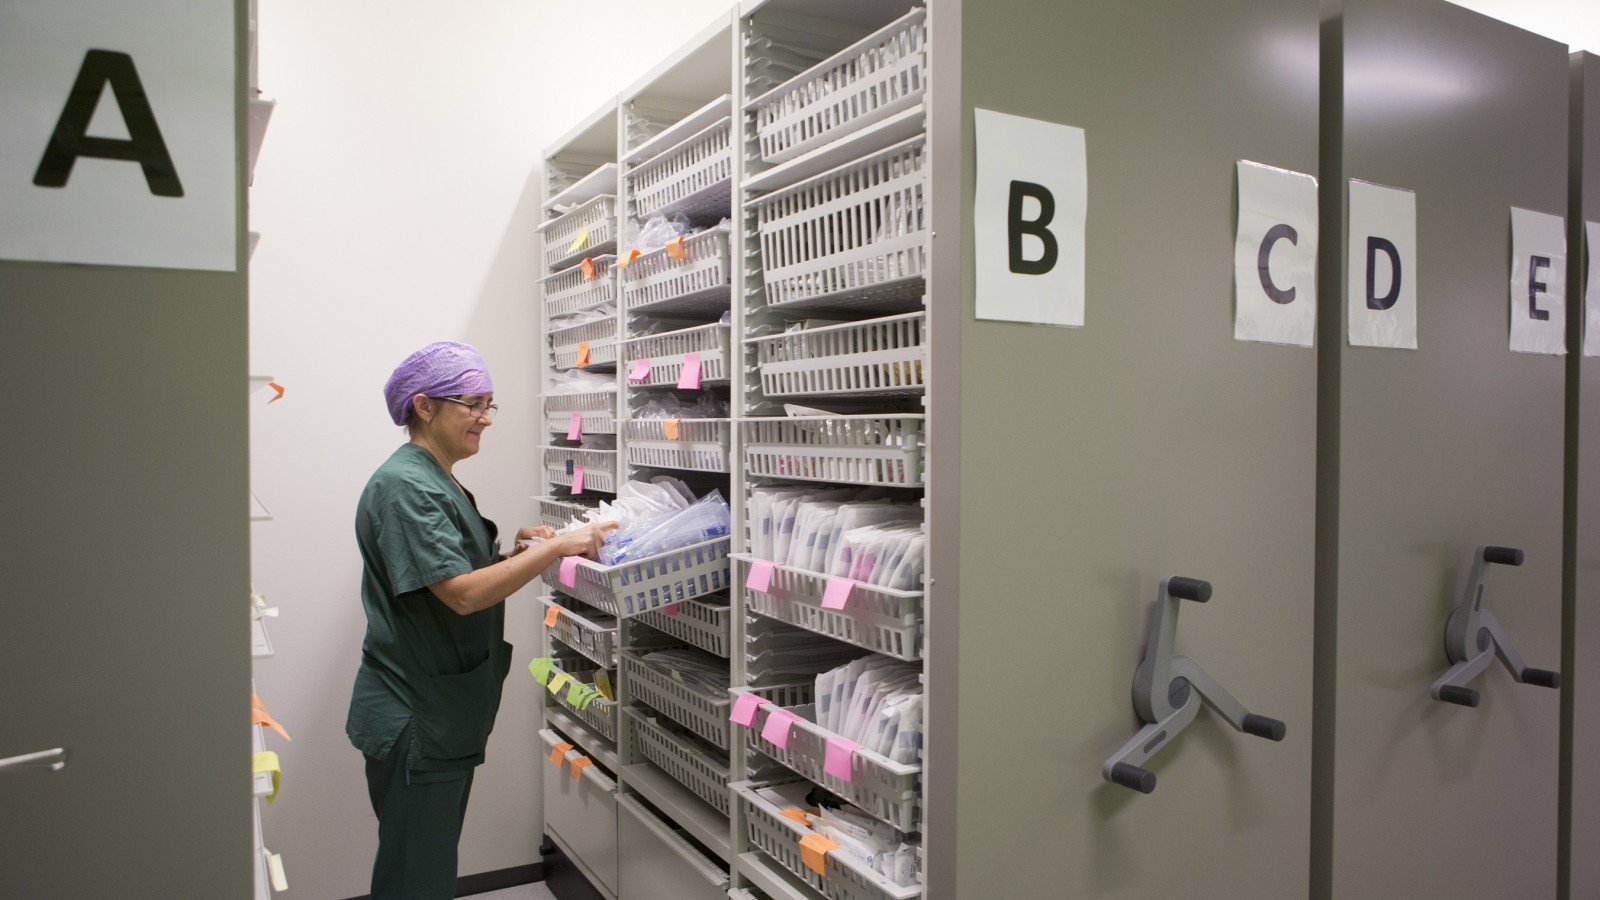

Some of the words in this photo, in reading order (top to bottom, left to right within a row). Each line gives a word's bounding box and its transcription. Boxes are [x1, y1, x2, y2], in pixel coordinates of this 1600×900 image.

[33, 48, 184, 198] A
[1008, 180, 1058, 275] B
[1257, 223, 1298, 305] C
[1366, 236, 1402, 311] D
[1528, 255, 1551, 321] E
